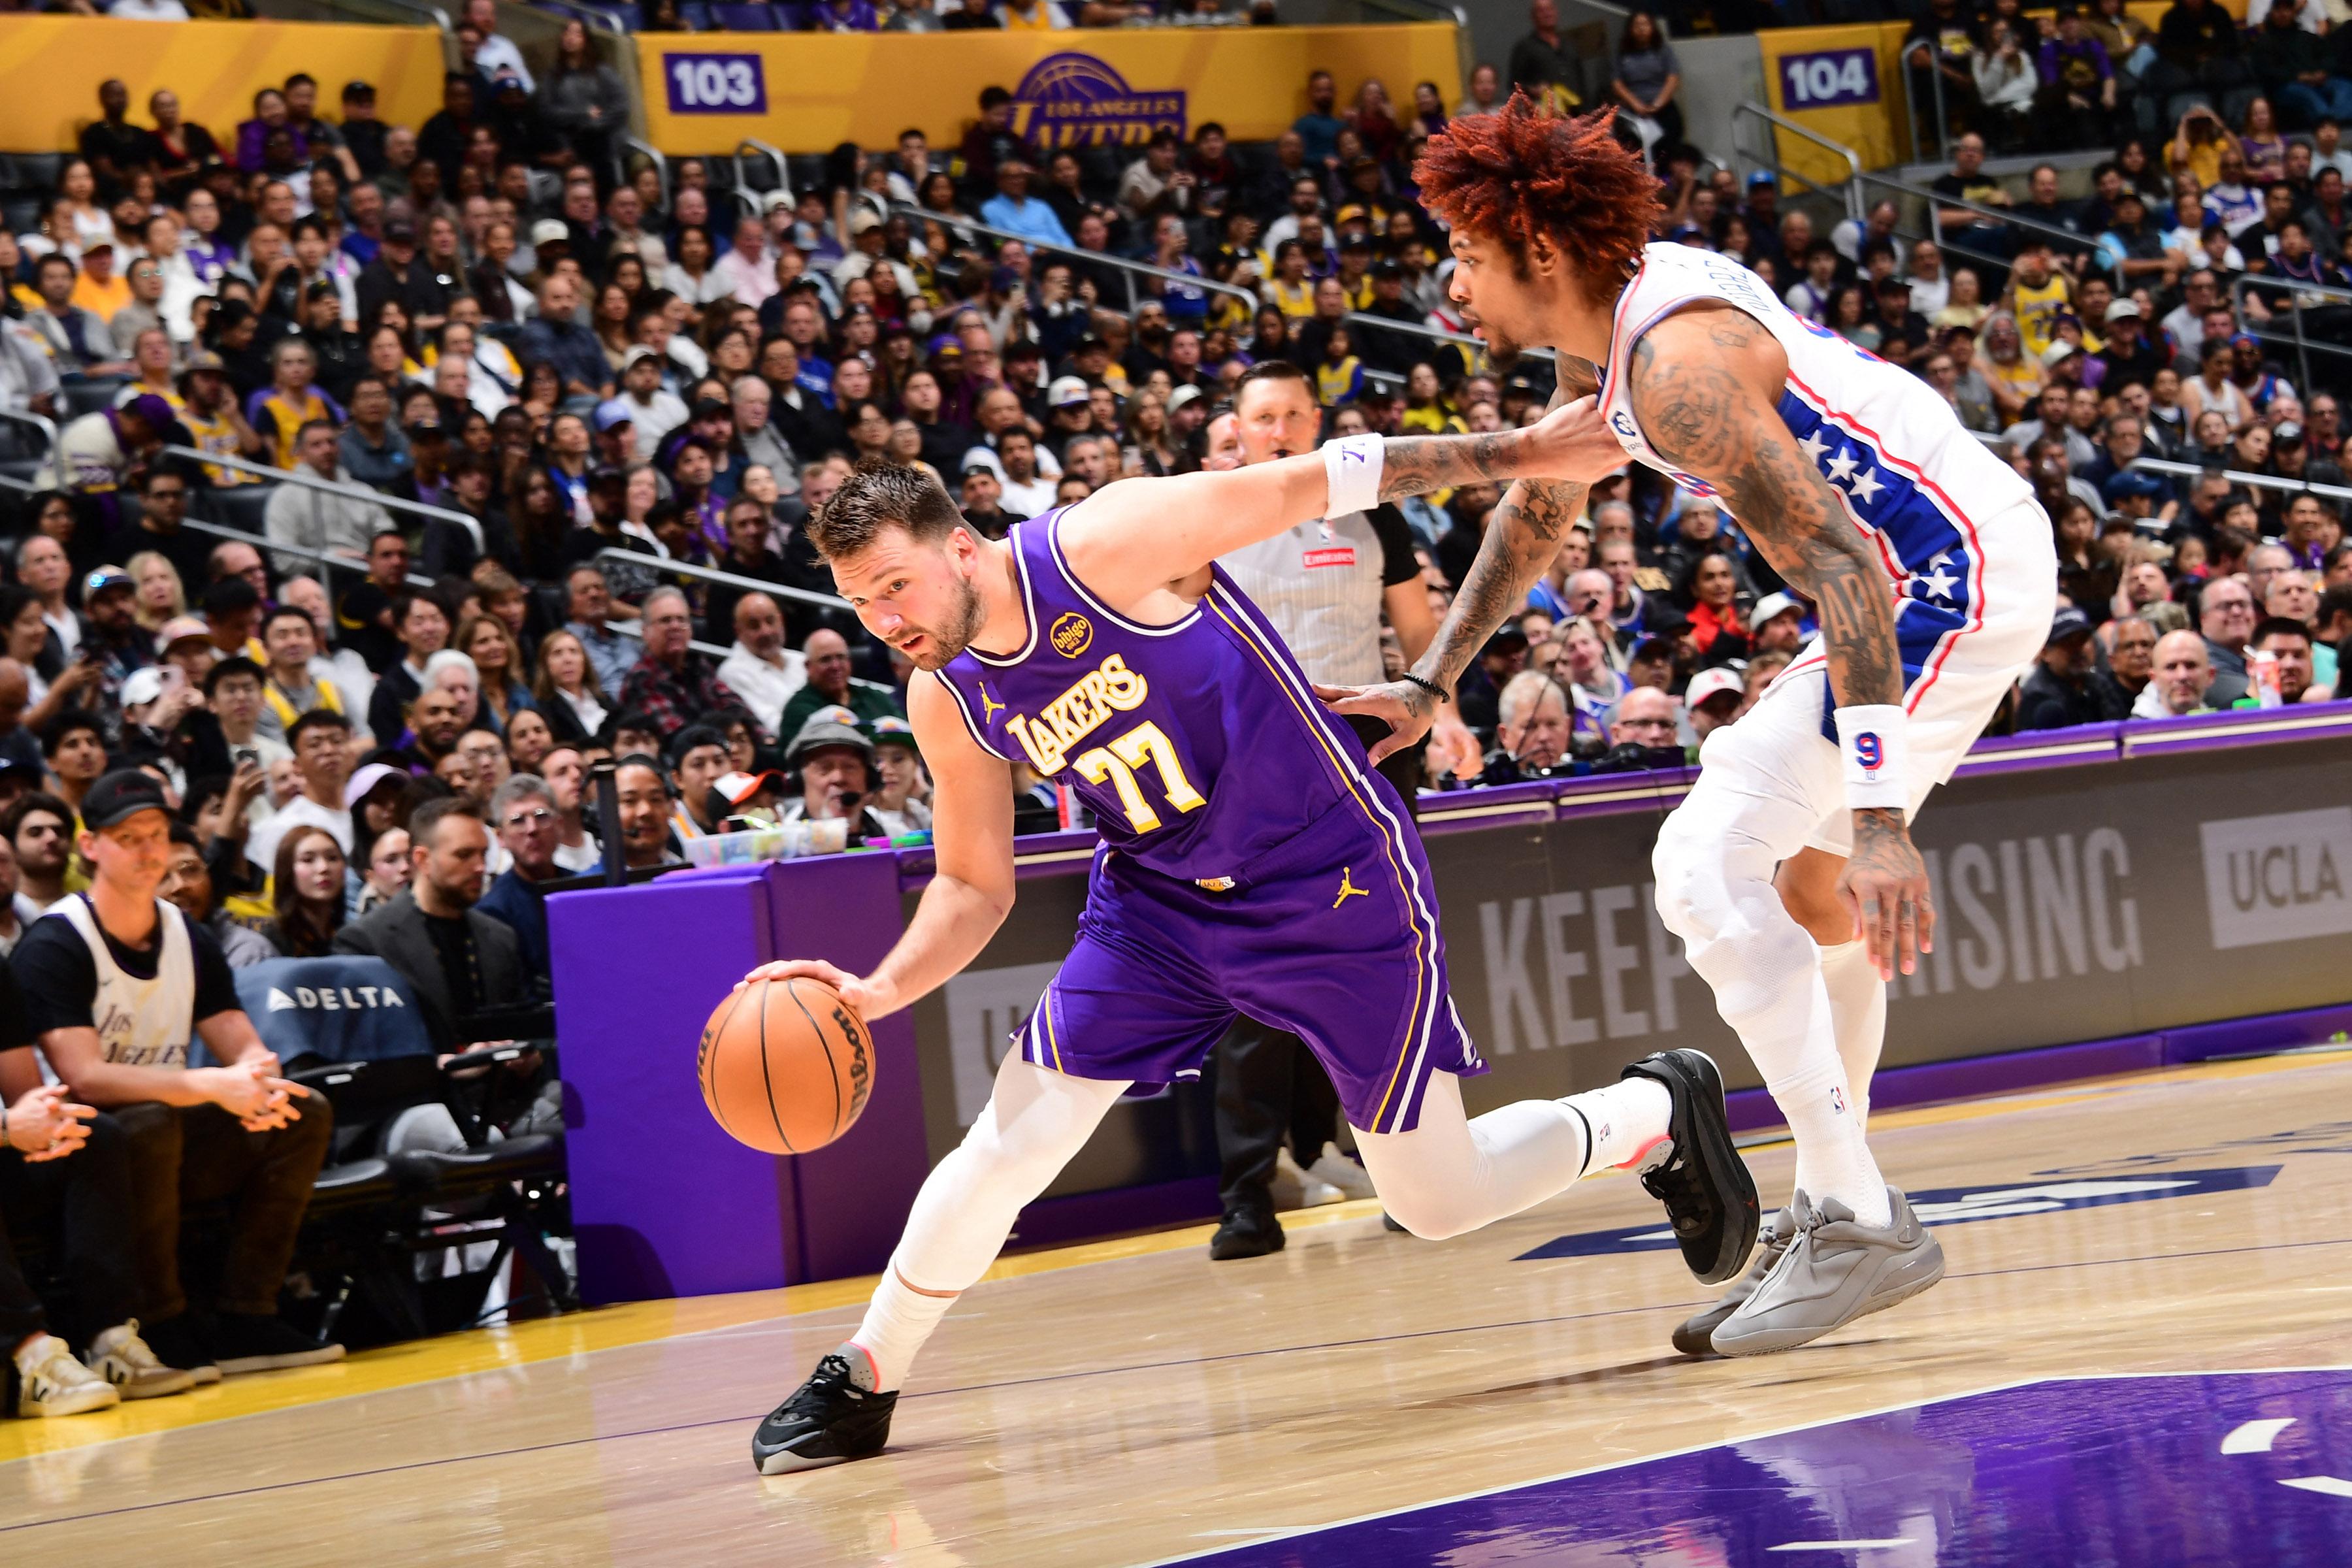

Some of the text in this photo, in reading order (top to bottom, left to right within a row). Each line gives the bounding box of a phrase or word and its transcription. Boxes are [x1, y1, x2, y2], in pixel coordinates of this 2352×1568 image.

[673, 59, 757, 106] 103
[1788, 55, 1870, 101] 104
[1045, 100, 1178, 118] LOS ANGELES
[1305, 553, 1354, 564] Emirates
[1054, 620, 1087, 649] bibigo
[1005, 653, 1149, 776] LAKERS
[1854, 731, 1883, 770] 9
[1071, 720, 1207, 834] 77
[2227, 843, 2344, 912] UCLA
[1478, 883, 1692, 1055] KEEP
[296, 986, 404, 1011] DELTA
[832, 1006, 868, 1125] Wilson
